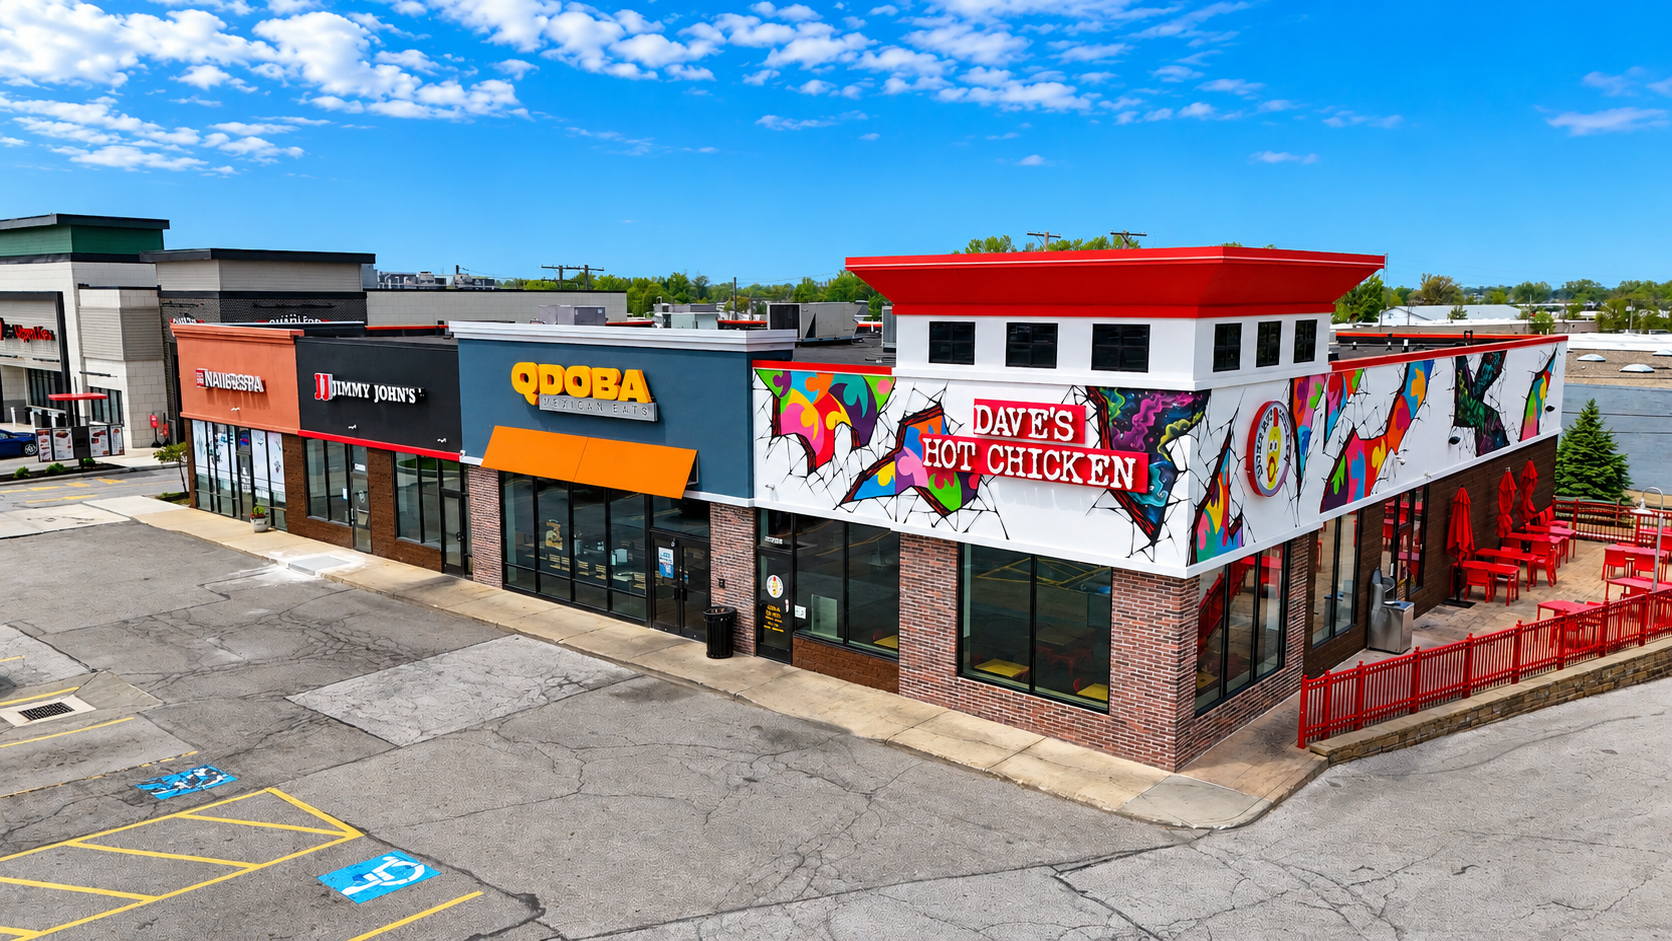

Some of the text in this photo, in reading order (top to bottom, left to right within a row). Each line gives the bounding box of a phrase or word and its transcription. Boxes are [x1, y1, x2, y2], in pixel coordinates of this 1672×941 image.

[332, 380, 371, 399] JIMMY
[373, 384, 417, 404] JOHN'S
[511, 361, 653, 406] QDOBA
[543, 397, 649, 417] MEXICAN EATS
[973, 404, 1075, 442] DAVE'S
[922, 437, 1137, 490] HOT CHICKEN
